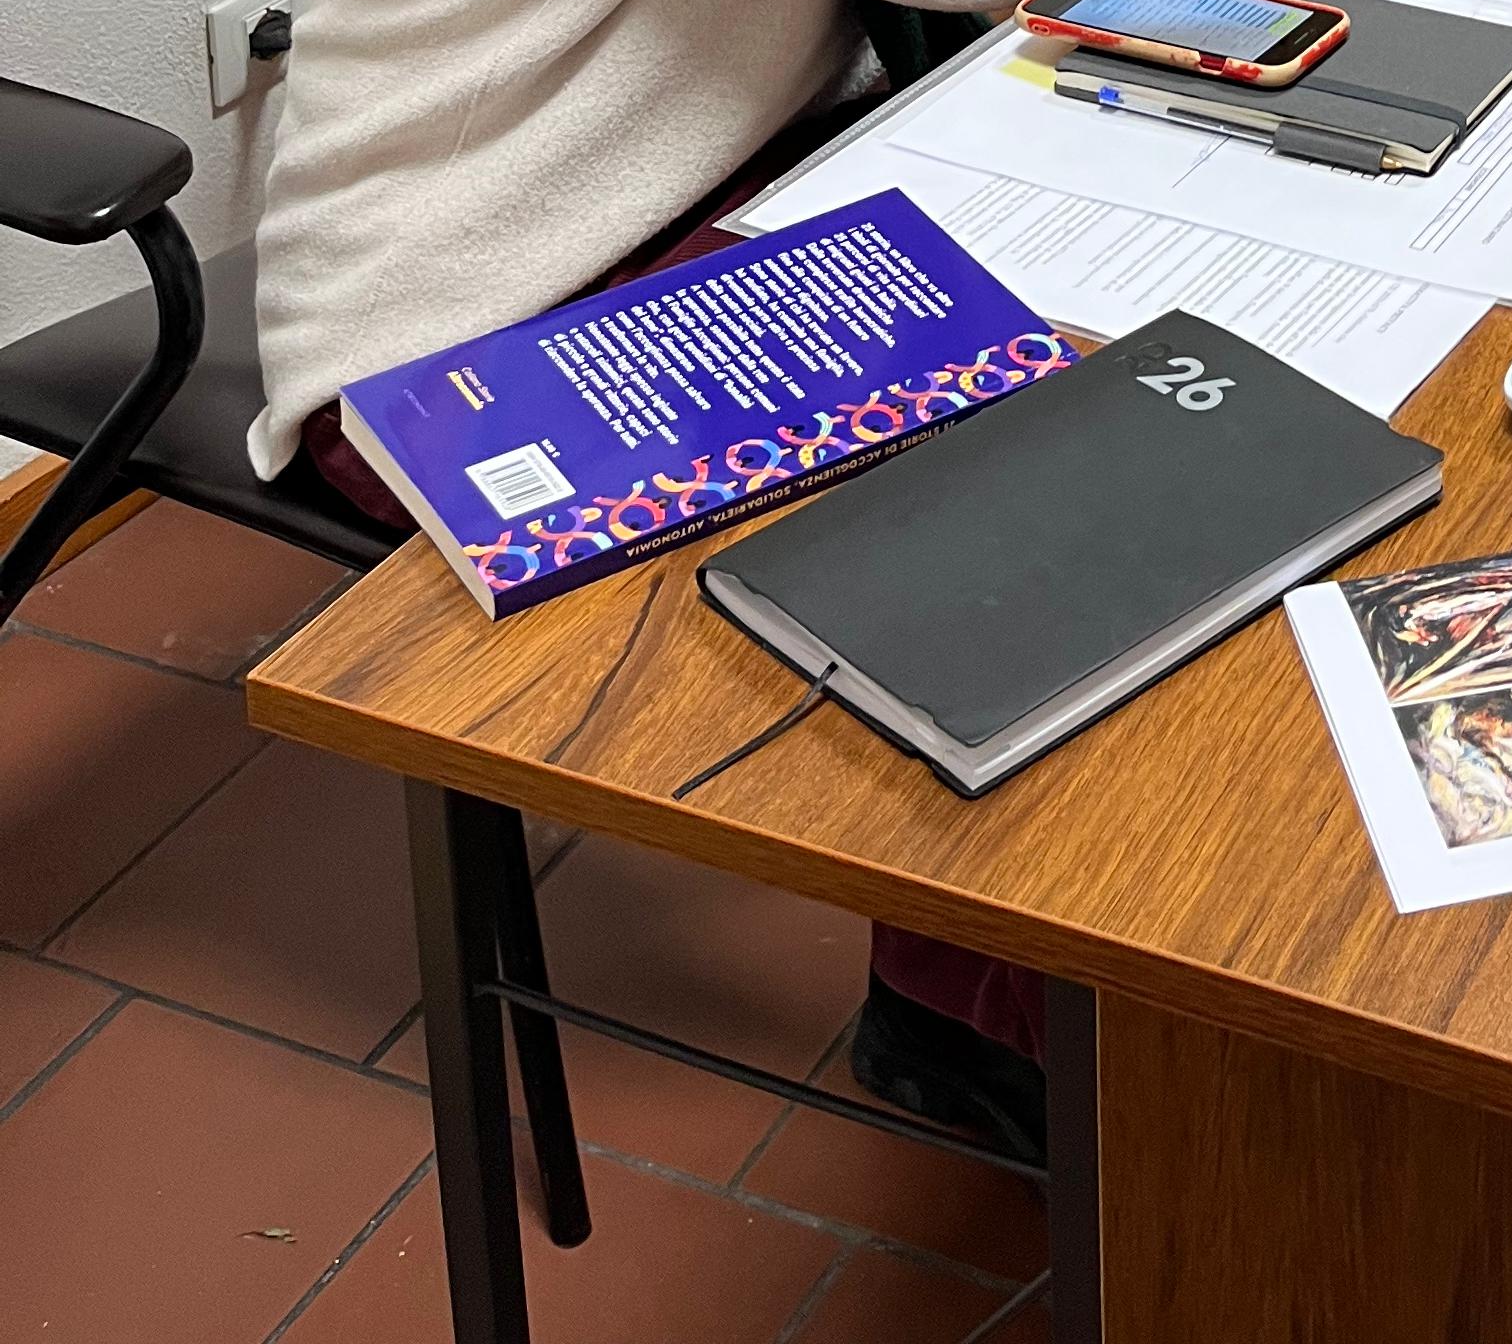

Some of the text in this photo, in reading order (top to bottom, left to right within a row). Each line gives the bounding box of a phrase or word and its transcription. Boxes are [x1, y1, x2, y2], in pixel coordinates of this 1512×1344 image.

[1136, 361, 1237, 410] 26
[884, 442, 897, 456] DI
[625, 518, 704, 560] AUTONOMIA
